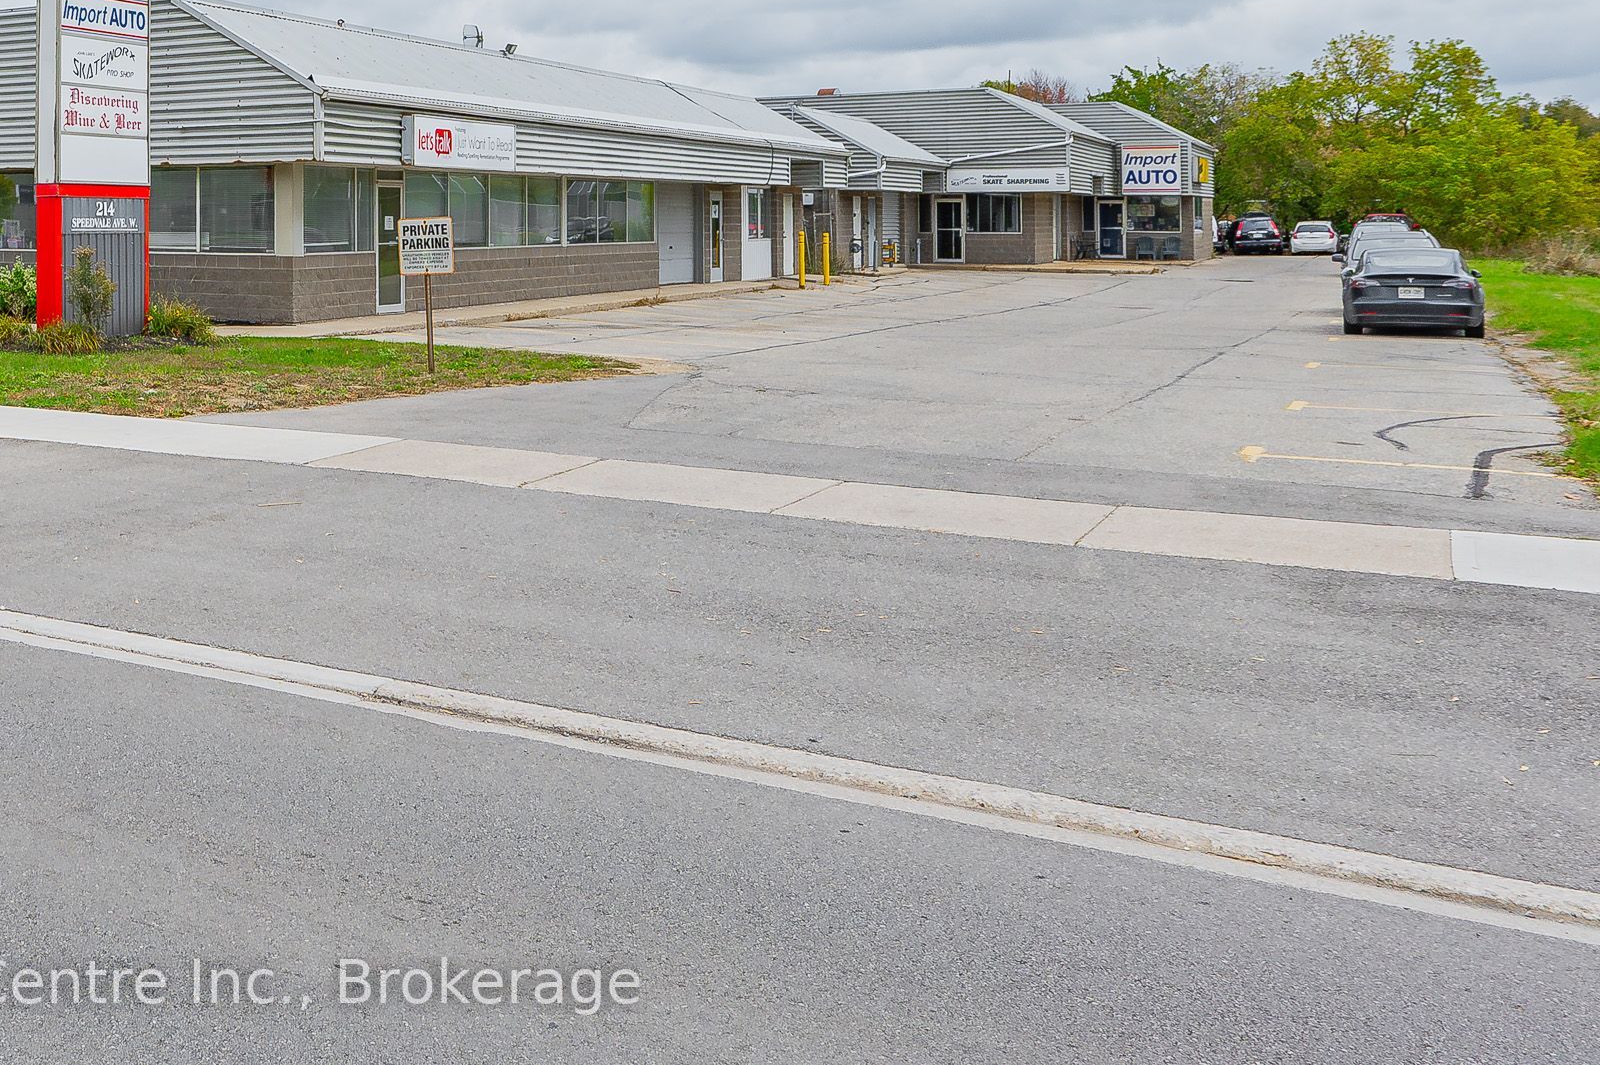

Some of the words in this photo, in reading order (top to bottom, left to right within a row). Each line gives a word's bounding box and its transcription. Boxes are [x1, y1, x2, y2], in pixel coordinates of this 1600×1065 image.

[63, 0, 107, 26] Import
[109, 7, 146, 31] AUTO
[72, 46, 136, 80] SKATEWORX
[106, 68, 119, 77] PRO
[120, 70, 135, 78] SHOP
[69, 87, 139, 115] Discovering
[63, 109, 96, 132] Wine
[99, 112, 111, 129] &
[114, 112, 142, 135] Beer
[418, 128, 434, 151] let's
[435, 131, 452, 153] talk
[1123, 152, 1177, 167] Import
[1124, 169, 1178, 184] AUTO
[95, 201, 116, 217] 214
[71, 217, 111, 228] SPEEDVALE
[128, 217, 138, 228] W.
[402, 223, 448, 237] PRIVATE
[402, 237, 450, 250] PARKING
